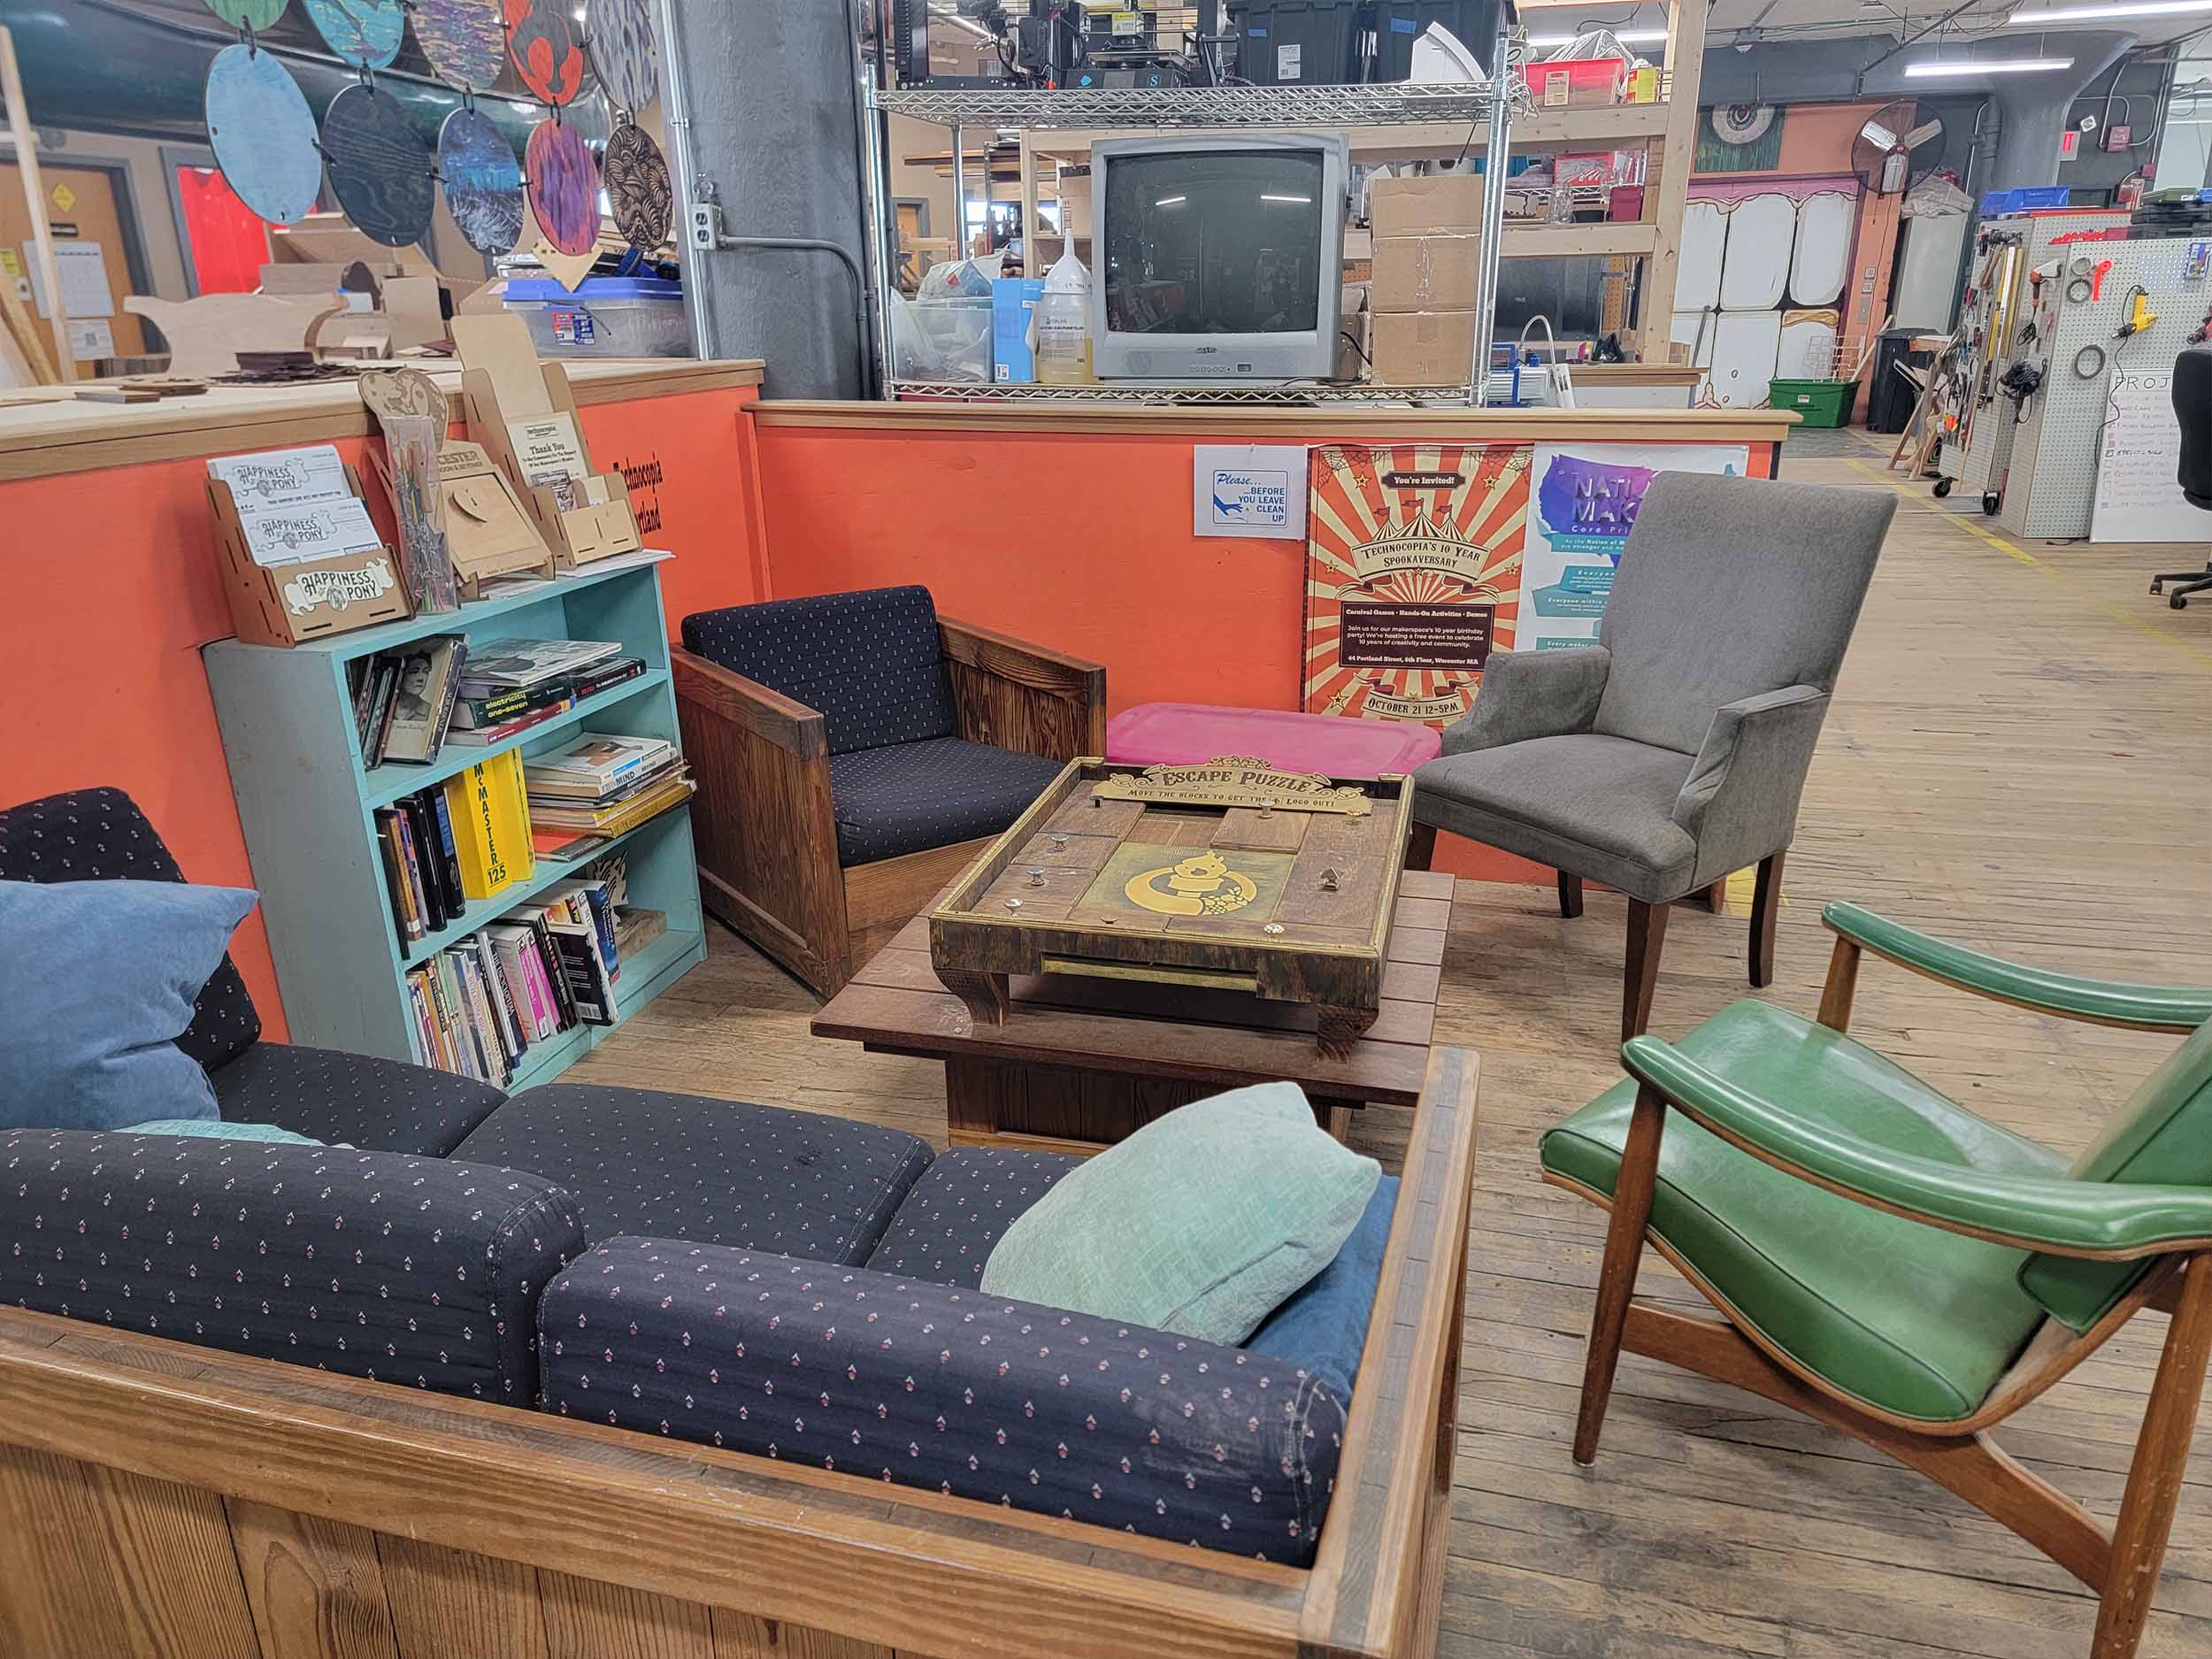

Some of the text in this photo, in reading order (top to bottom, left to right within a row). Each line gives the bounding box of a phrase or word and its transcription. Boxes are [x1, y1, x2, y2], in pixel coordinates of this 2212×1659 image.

[2062, 133, 2075, 153] IT
[2115, 376, 2172, 391] PROJ
[439, 450, 480, 465] CESTER
[529, 442, 565, 455] Thank You
[237, 465, 292, 486] HAPPINESS
[613, 450, 663, 495] chnocopia
[1394, 476, 1455, 485] You're Invited!
[272, 474, 296, 490] PONY
[1575, 474, 1632, 497] NATI
[1258, 495, 1285, 504] LEAVE
[634, 496, 662, 536] rtland
[1572, 497, 1636, 523] MAK
[261, 518, 318, 539] HAPPINESS
[298, 526, 324, 541] PONY
[1361, 541, 1481, 562] TECHNOCOPIA'S 10 YEAR
[1383, 555, 1458, 568] SPOOKAVERSARY
[301, 570, 372, 597] HAPPINESS
[346, 580, 377, 600] PONY
[1392, 626, 1434, 634] makerspace's
[485, 692, 527, 710] electricity
[488, 701, 528, 718] one-seven
[1368, 697, 1459, 715] OCTOBER 21 12-5PM
[616, 771, 635, 787] MIND
[1162, 771, 1313, 794] ESCAPE PUZZLE
[488, 864, 507, 885] 125
